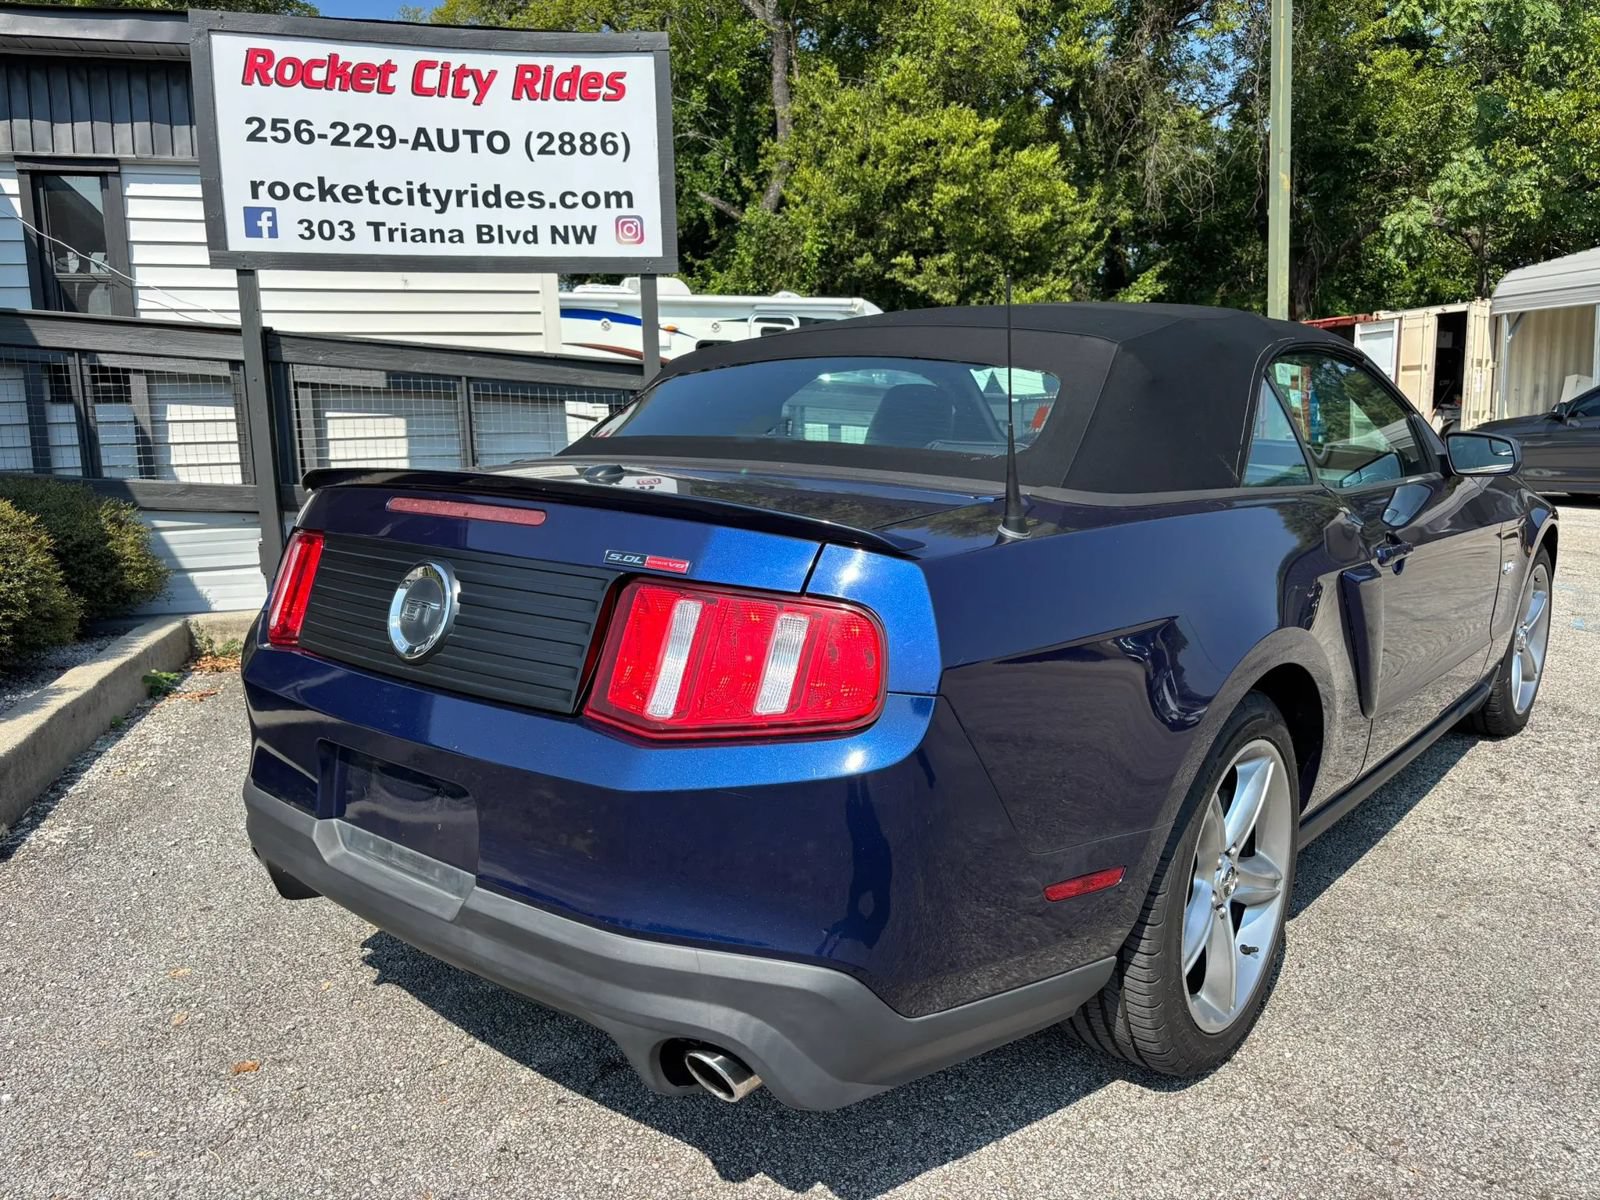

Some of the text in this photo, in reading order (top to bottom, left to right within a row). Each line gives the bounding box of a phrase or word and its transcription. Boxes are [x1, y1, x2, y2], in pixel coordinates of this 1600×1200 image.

[242, 48, 627, 106] Rocket City Rides
[245, 117, 631, 162] 256-229-AUTO (2886)
[250, 176, 634, 214] rocketcityrides.com
[297, 218, 598, 245] 303 Triana Blvd NW
[607, 553, 644, 564] 5.0L
[402, 598, 441, 625] GT
